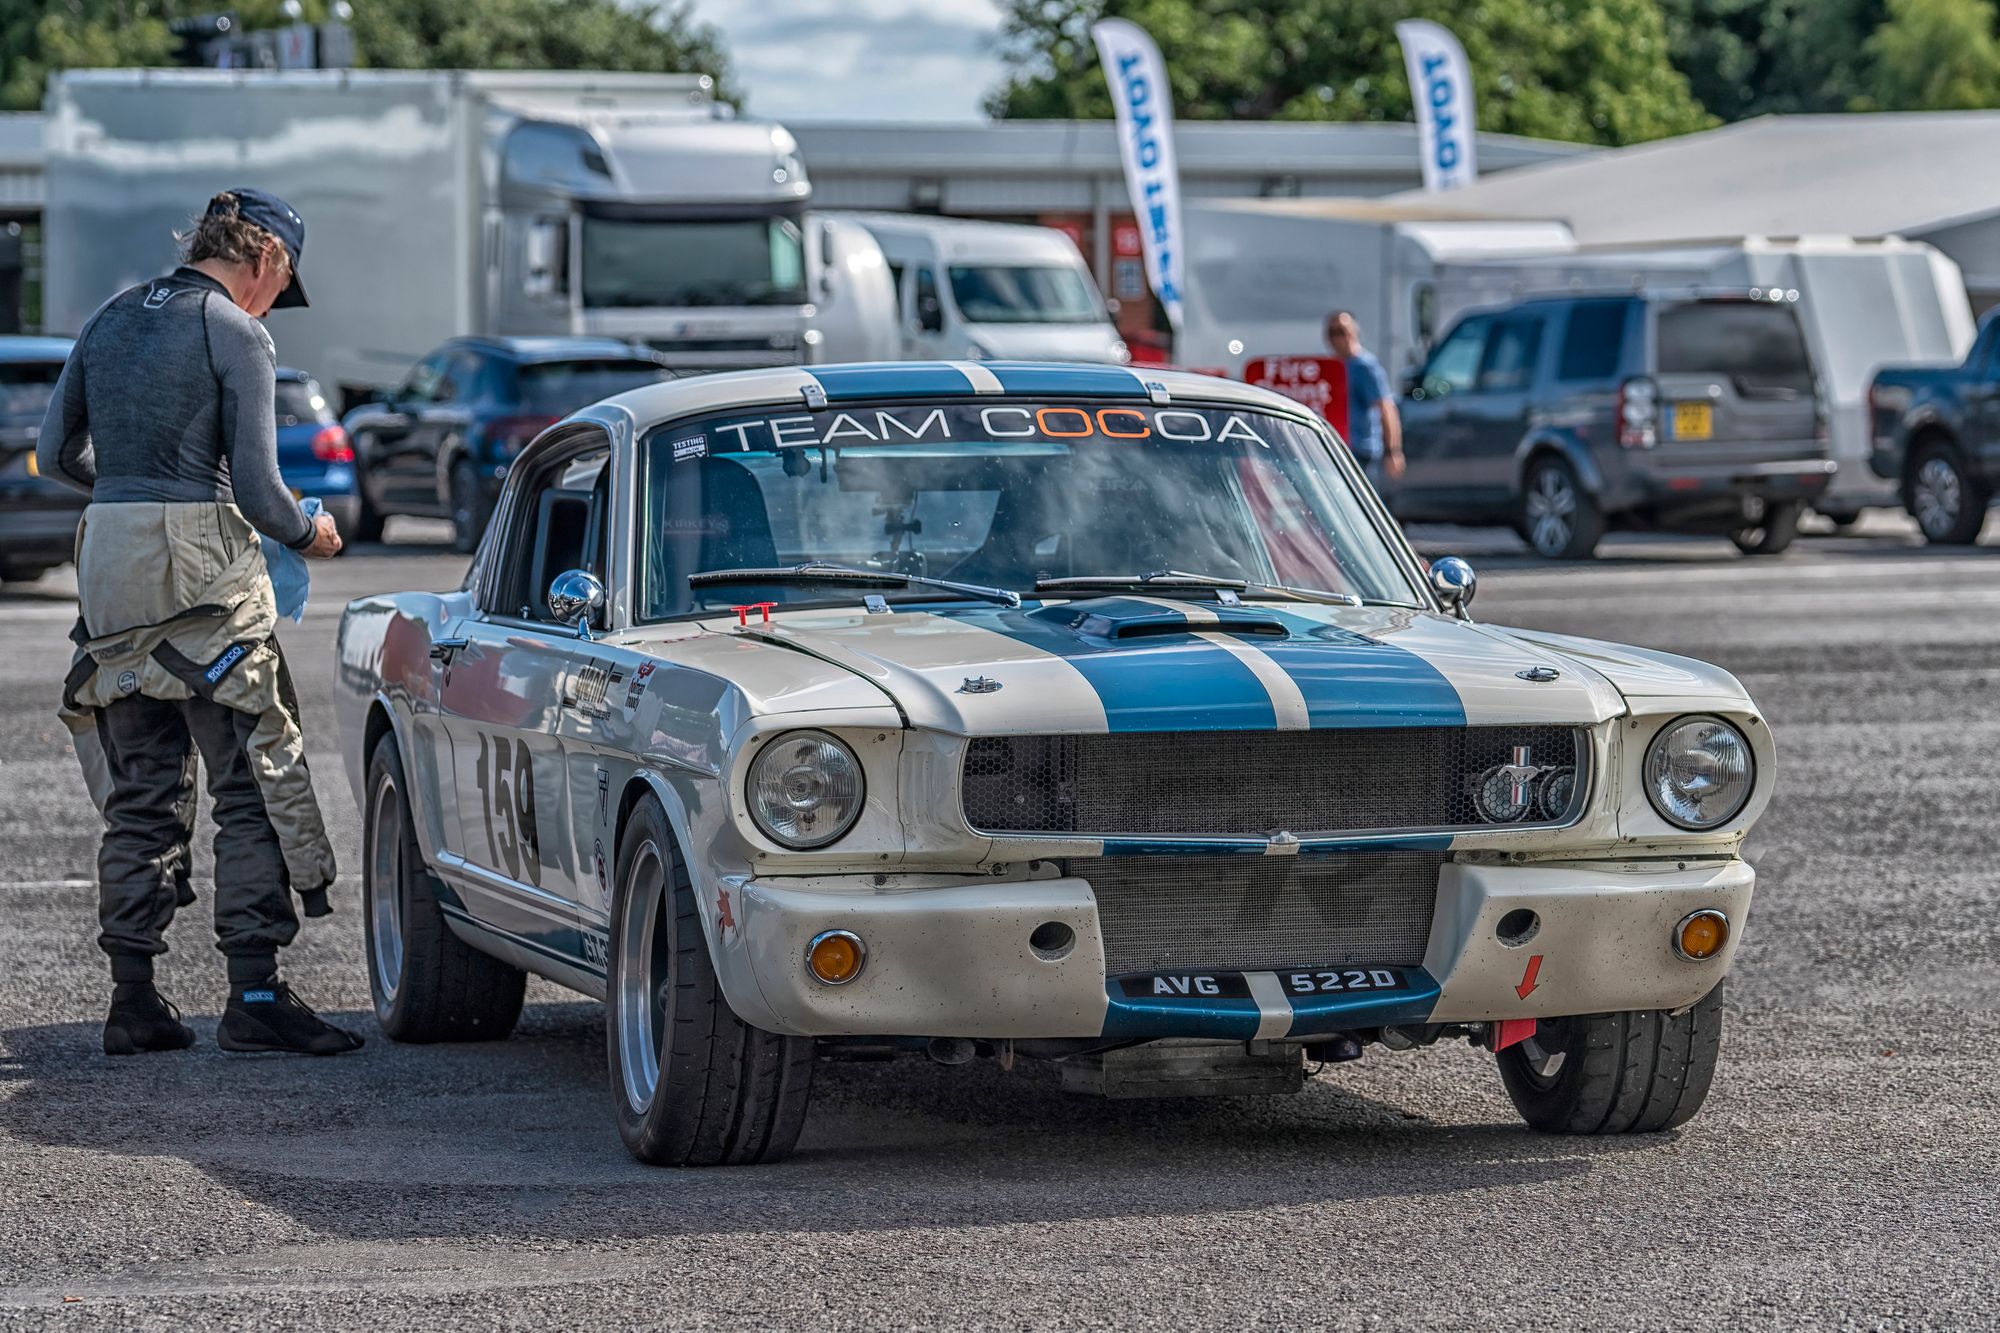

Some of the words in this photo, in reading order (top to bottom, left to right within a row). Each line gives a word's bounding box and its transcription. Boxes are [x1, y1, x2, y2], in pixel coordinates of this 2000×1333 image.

[1264, 356, 1320, 382] Fire
[715, 408, 951, 451] TEAM
[980, 408, 1270, 449] COCOA
[673, 437, 704, 450] TESTING
[477, 731, 541, 888] 159
[1154, 976, 1221, 995] AVG
[1291, 970, 1396, 992] 522D
